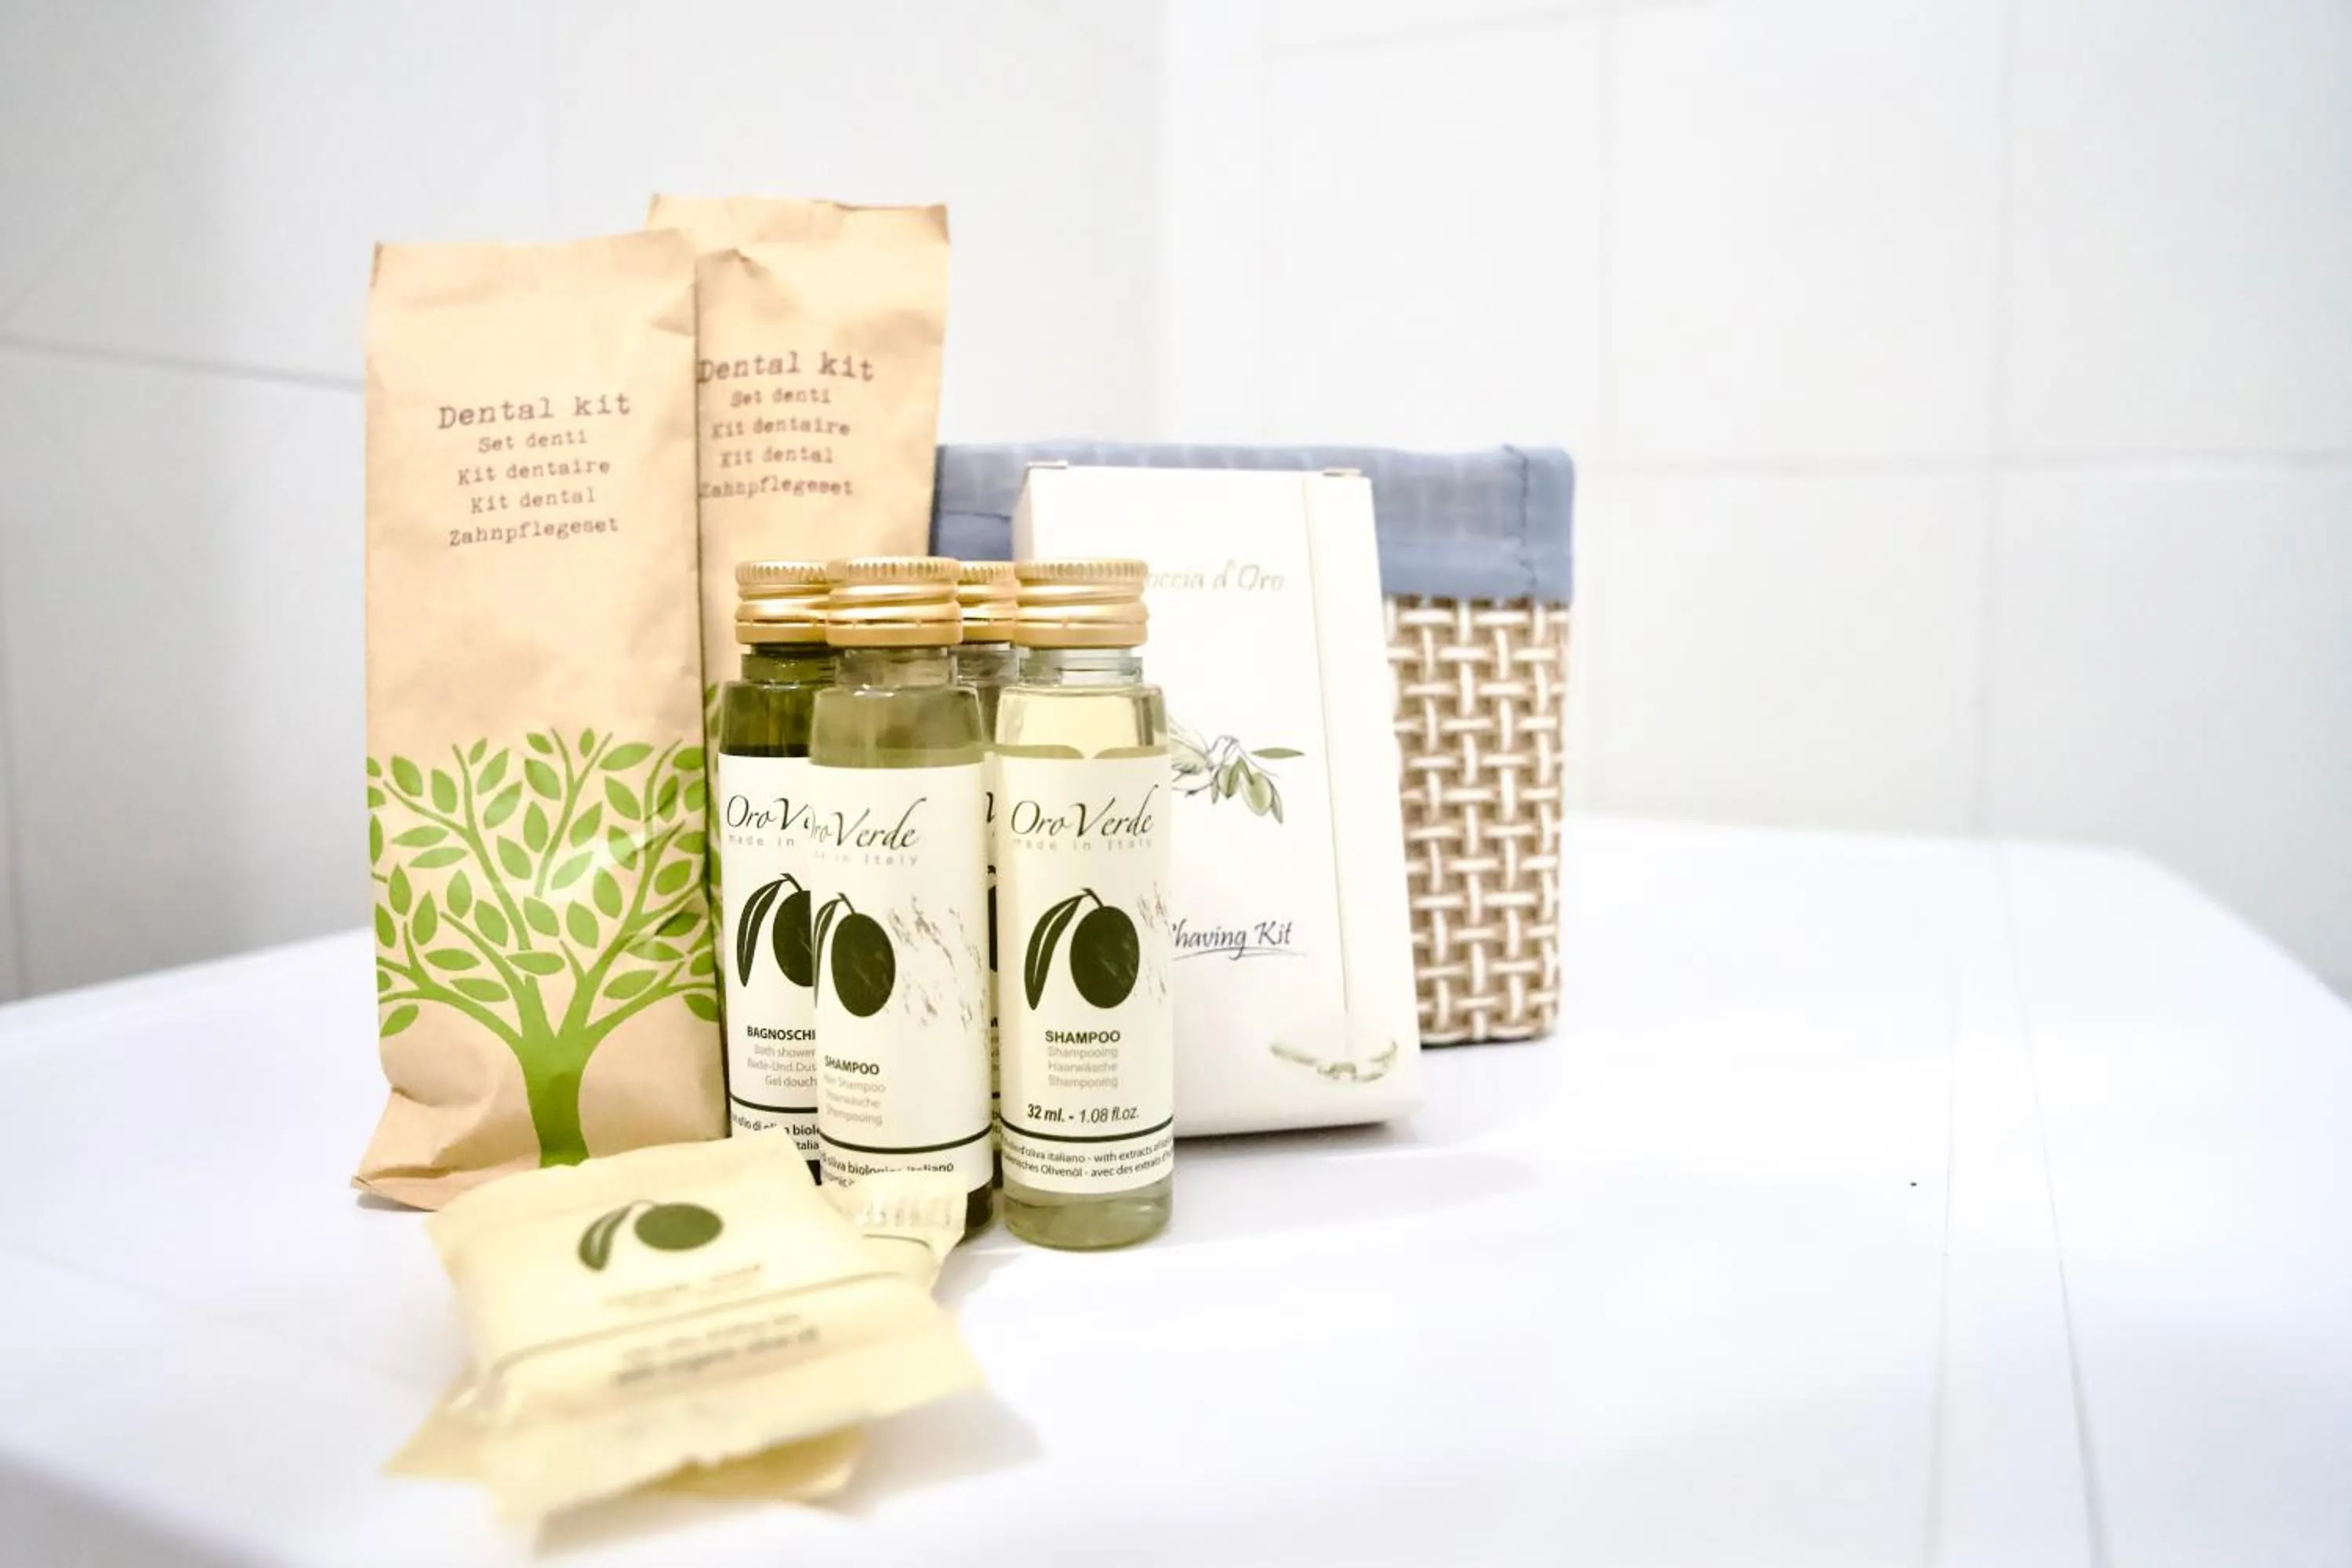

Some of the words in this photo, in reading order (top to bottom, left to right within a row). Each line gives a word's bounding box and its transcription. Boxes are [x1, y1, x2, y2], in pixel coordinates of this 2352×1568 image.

[696, 351, 800, 384] Dental
[818, 351, 875, 382] kit
[730, 390, 762, 408] Set
[771, 387, 831, 404] denti
[437, 397, 554, 430] Dental
[572, 392, 632, 417] kit
[711, 420, 745, 439] Kit
[753, 417, 851, 436] dentaire
[477, 435, 515, 454] Set
[525, 428, 588, 448] denti
[720, 449, 753, 469] Kit
[761, 446, 833, 464] dental
[457, 466, 497, 486] Kit
[506, 458, 611, 480] dentaire
[470, 495, 510, 515] Kit
[519, 486, 597, 508] dental
[448, 516, 620, 547] Zahnpflegeset
[1172, 918, 1247, 961] having
[1254, 920, 1292, 946] Kit
[1045, 1029, 1121, 1044] SHAMPOO
[825, 1054, 880, 1075] SHAMPOO
[1027, 1103, 1041, 1120] 32
[1044, 1108, 1065, 1123] ml.
[1080, 1108, 1108, 1123] 1.08
[1094, 1150, 1117, 1162] with
